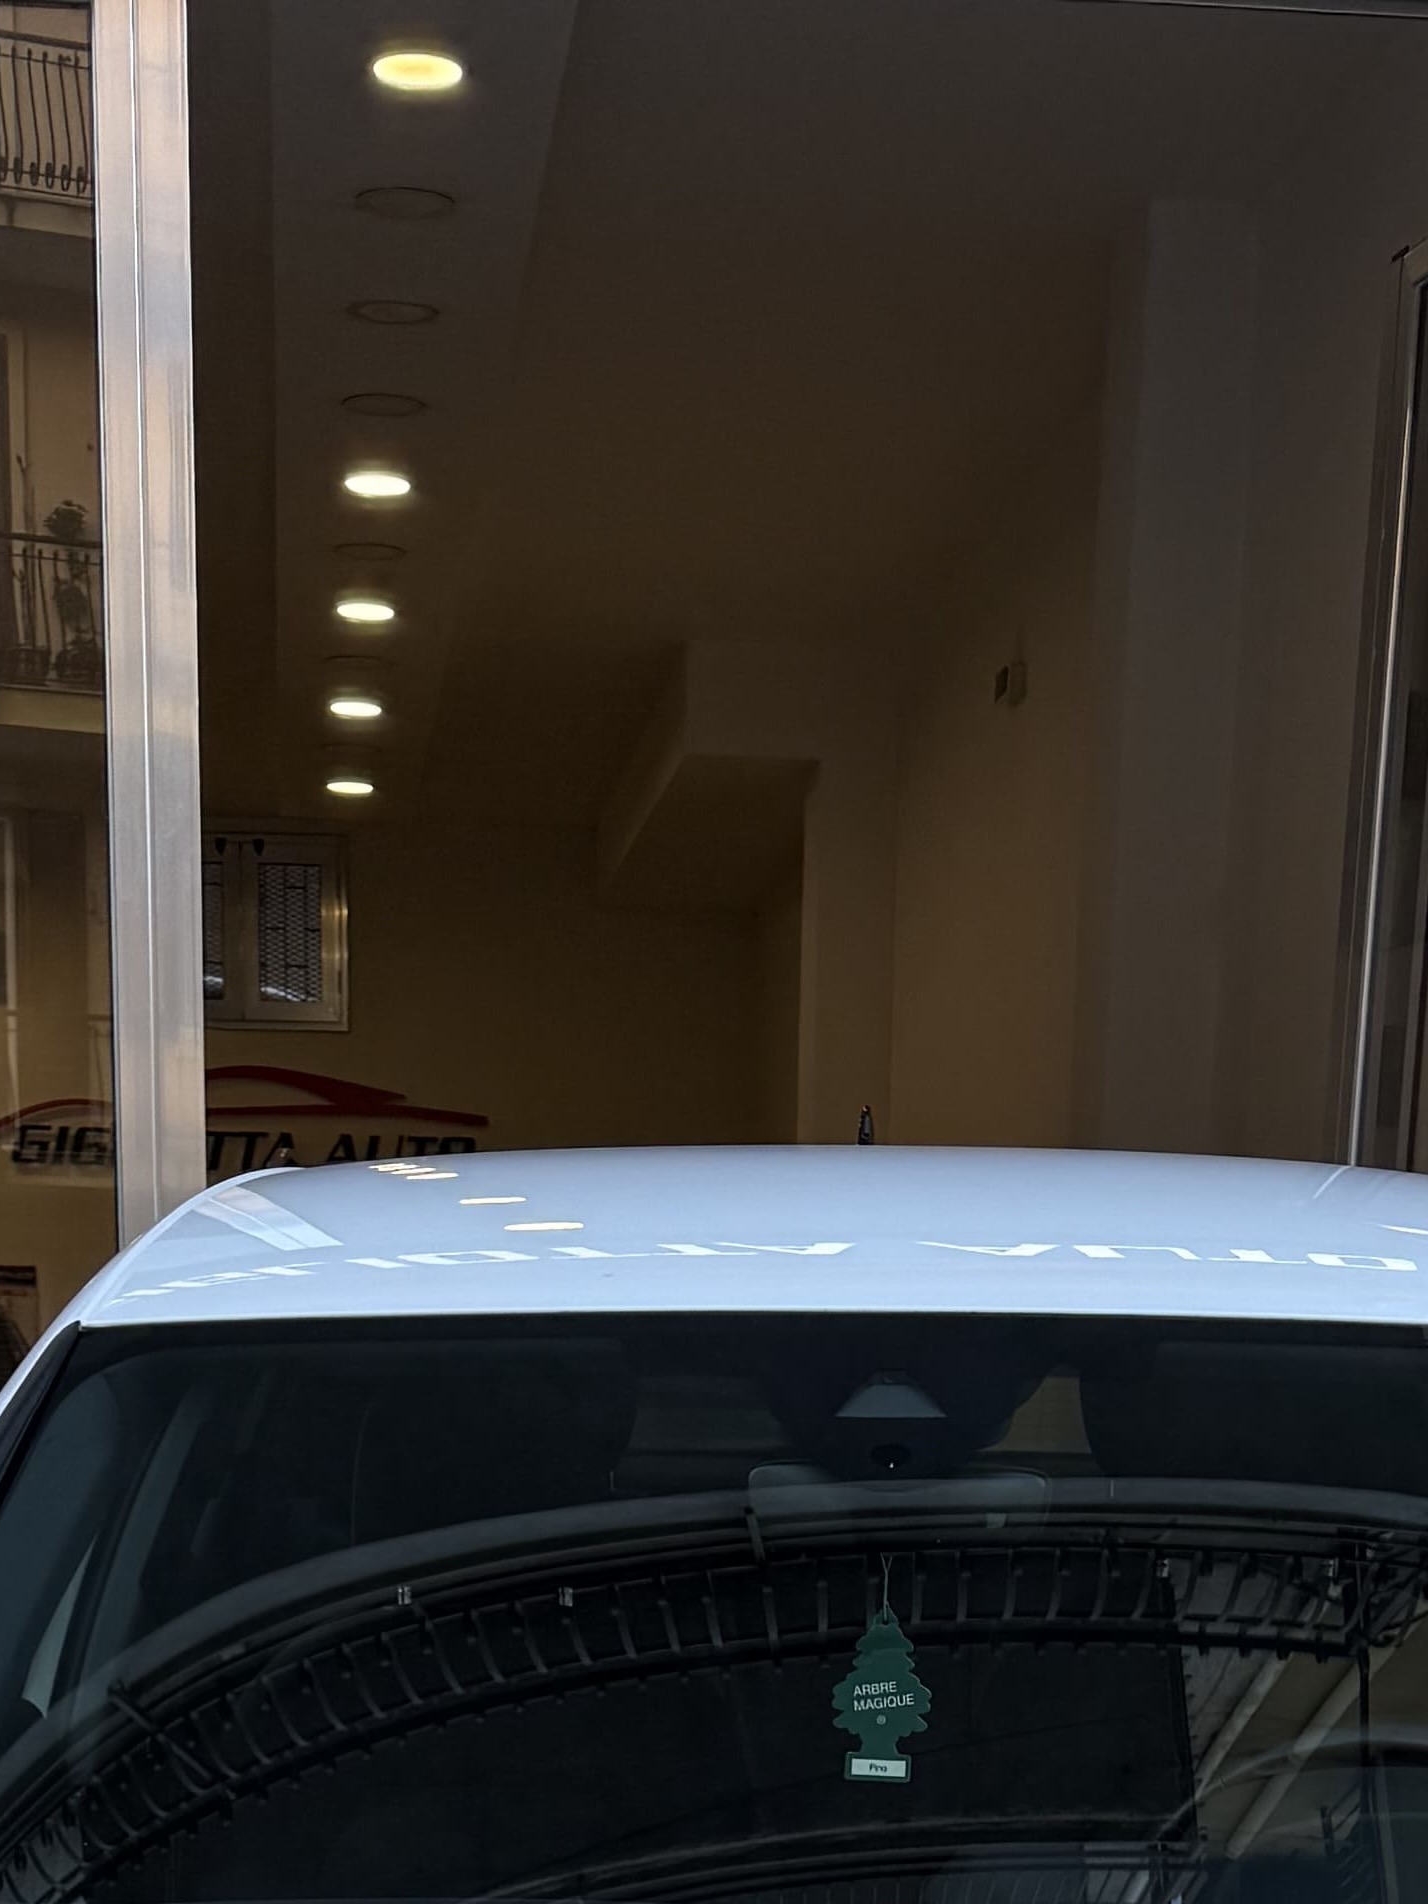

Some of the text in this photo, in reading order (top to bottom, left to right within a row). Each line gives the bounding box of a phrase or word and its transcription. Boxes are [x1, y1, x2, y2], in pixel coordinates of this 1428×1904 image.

[12, 1124, 298, 1171] GIGTTA
[853, 1681, 897, 1697] ARBRE
[853, 1693, 914, 1711] MAGIQUE
